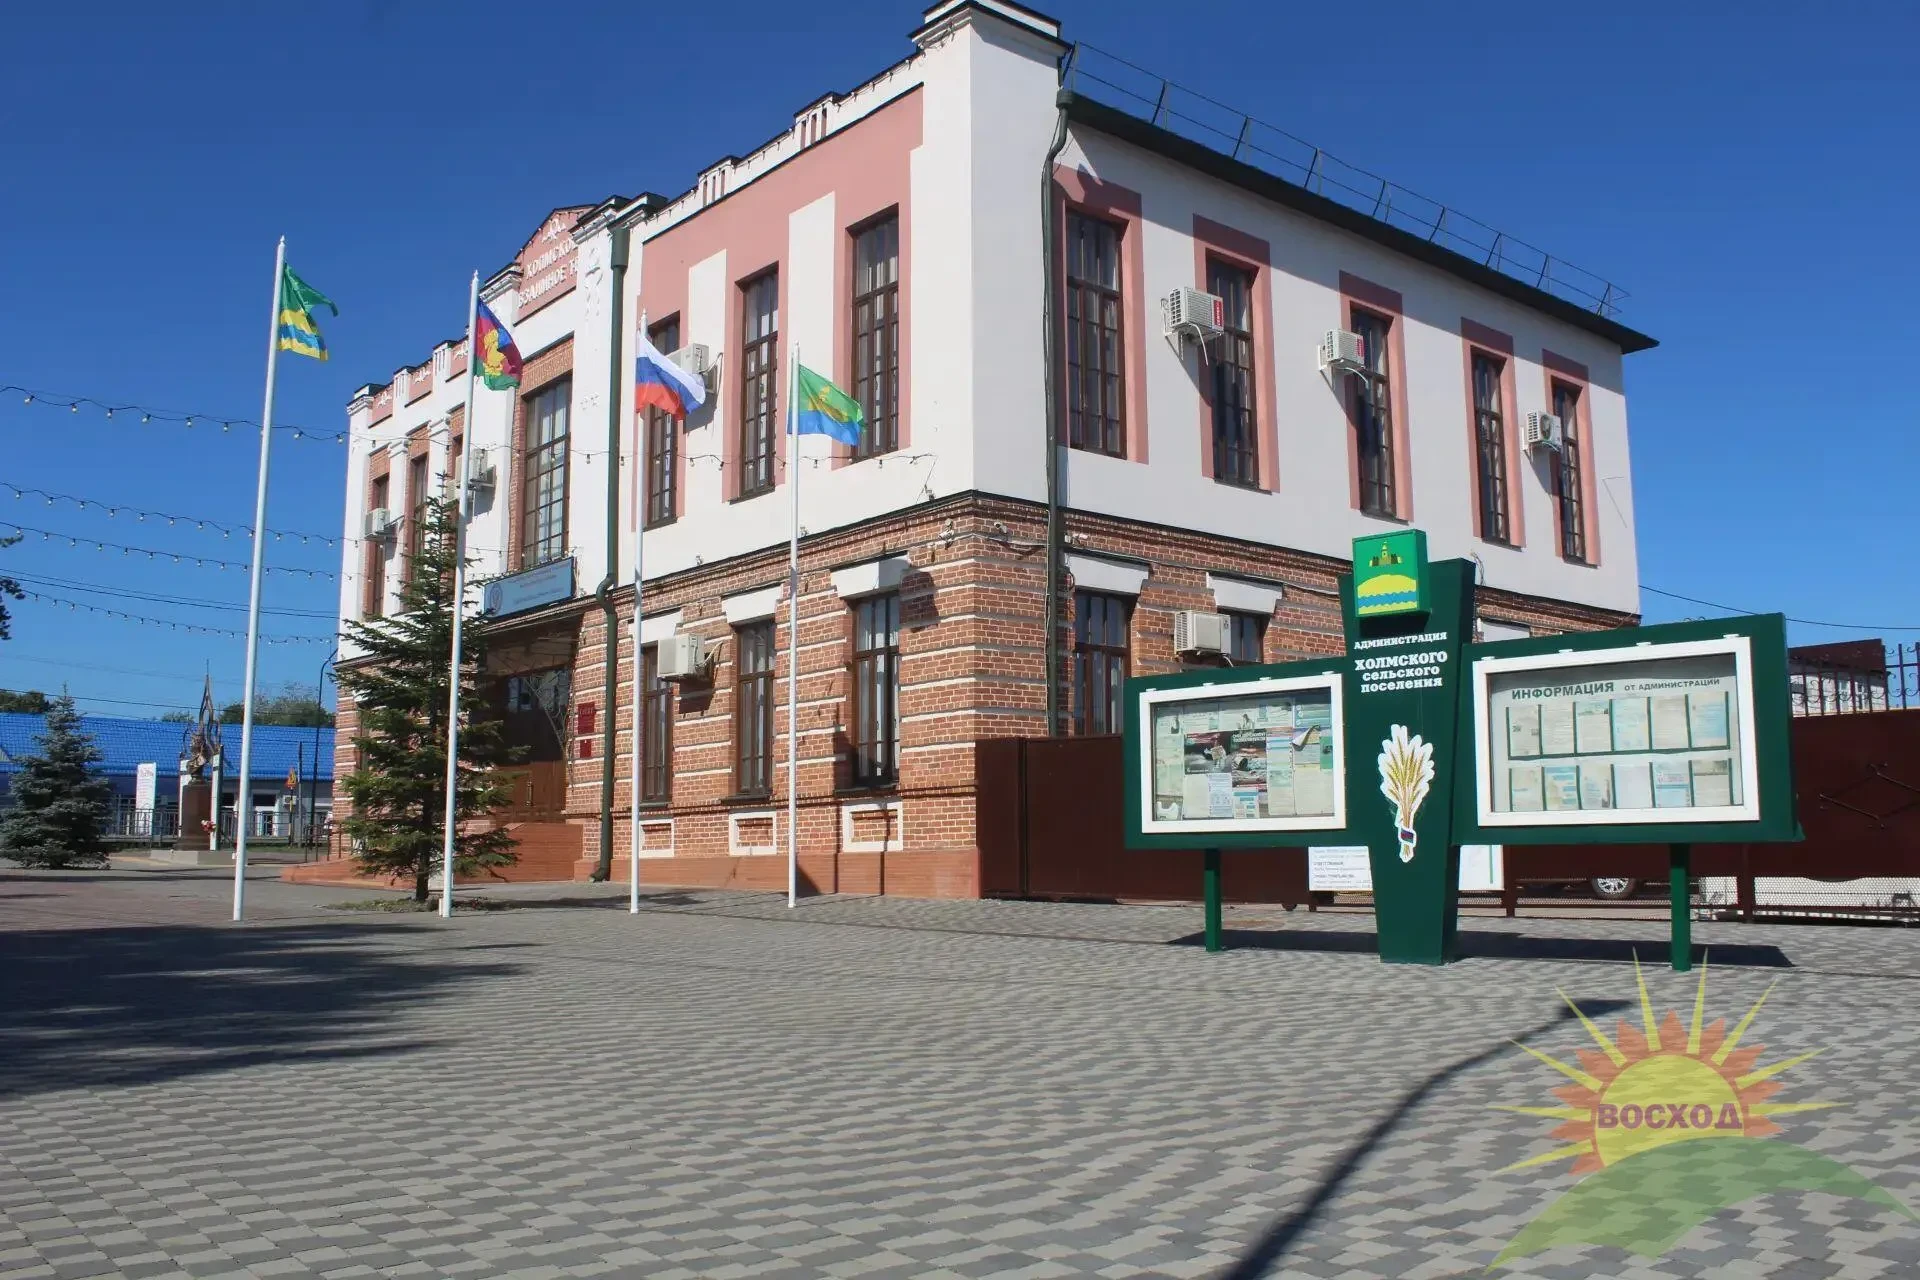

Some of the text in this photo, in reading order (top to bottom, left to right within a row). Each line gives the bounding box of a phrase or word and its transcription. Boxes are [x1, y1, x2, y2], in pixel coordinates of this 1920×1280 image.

[1354, 632, 1447, 650] АДМИНИСТРАЦИЯ
[1354, 651, 1448, 671] ХОЛМСКОГО
[1362, 666, 1440, 682] сельского
[1360, 678, 1442, 693] поселения
[1511, 682, 1614, 700] ИНФОРМАЦИЯ
[1638, 678, 1720, 691] АДМИНИСТРАЦИИ
